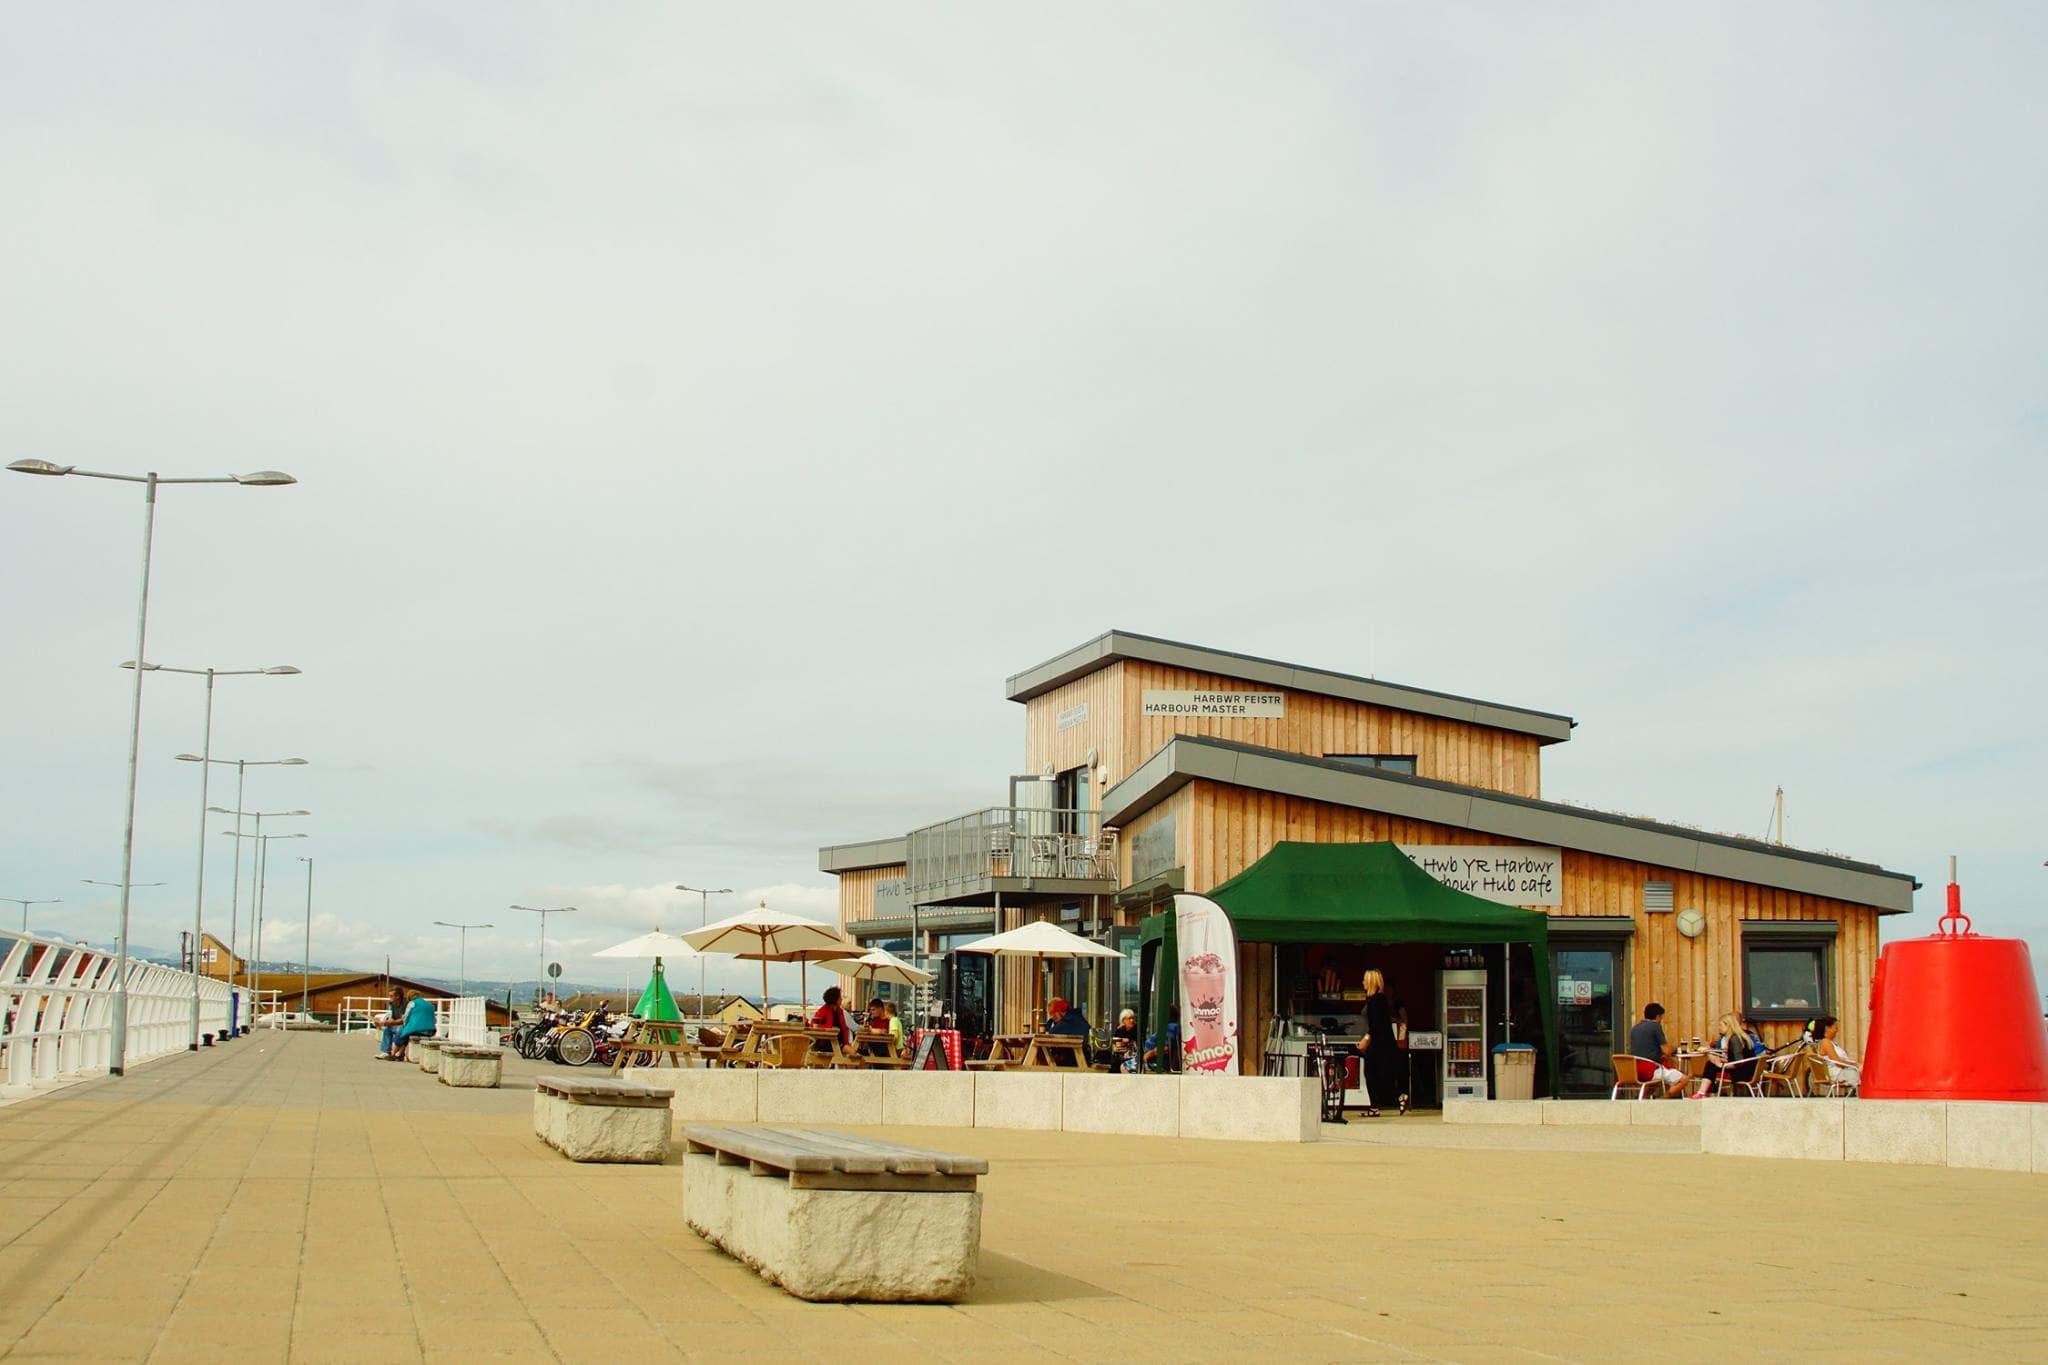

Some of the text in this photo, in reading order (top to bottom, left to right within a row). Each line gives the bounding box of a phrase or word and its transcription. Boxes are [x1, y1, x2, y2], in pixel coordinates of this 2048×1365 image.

[1145, 703, 1246, 714] HARBOUR MASTER
[1193, 694, 1281, 705] HARBWR FEISTR
[1423, 855, 1554, 879] Hwb YR Harbwr
[1439, 873, 1552, 898] bour Hub cafe
[1185, 1043, 1234, 1066] shmoo
